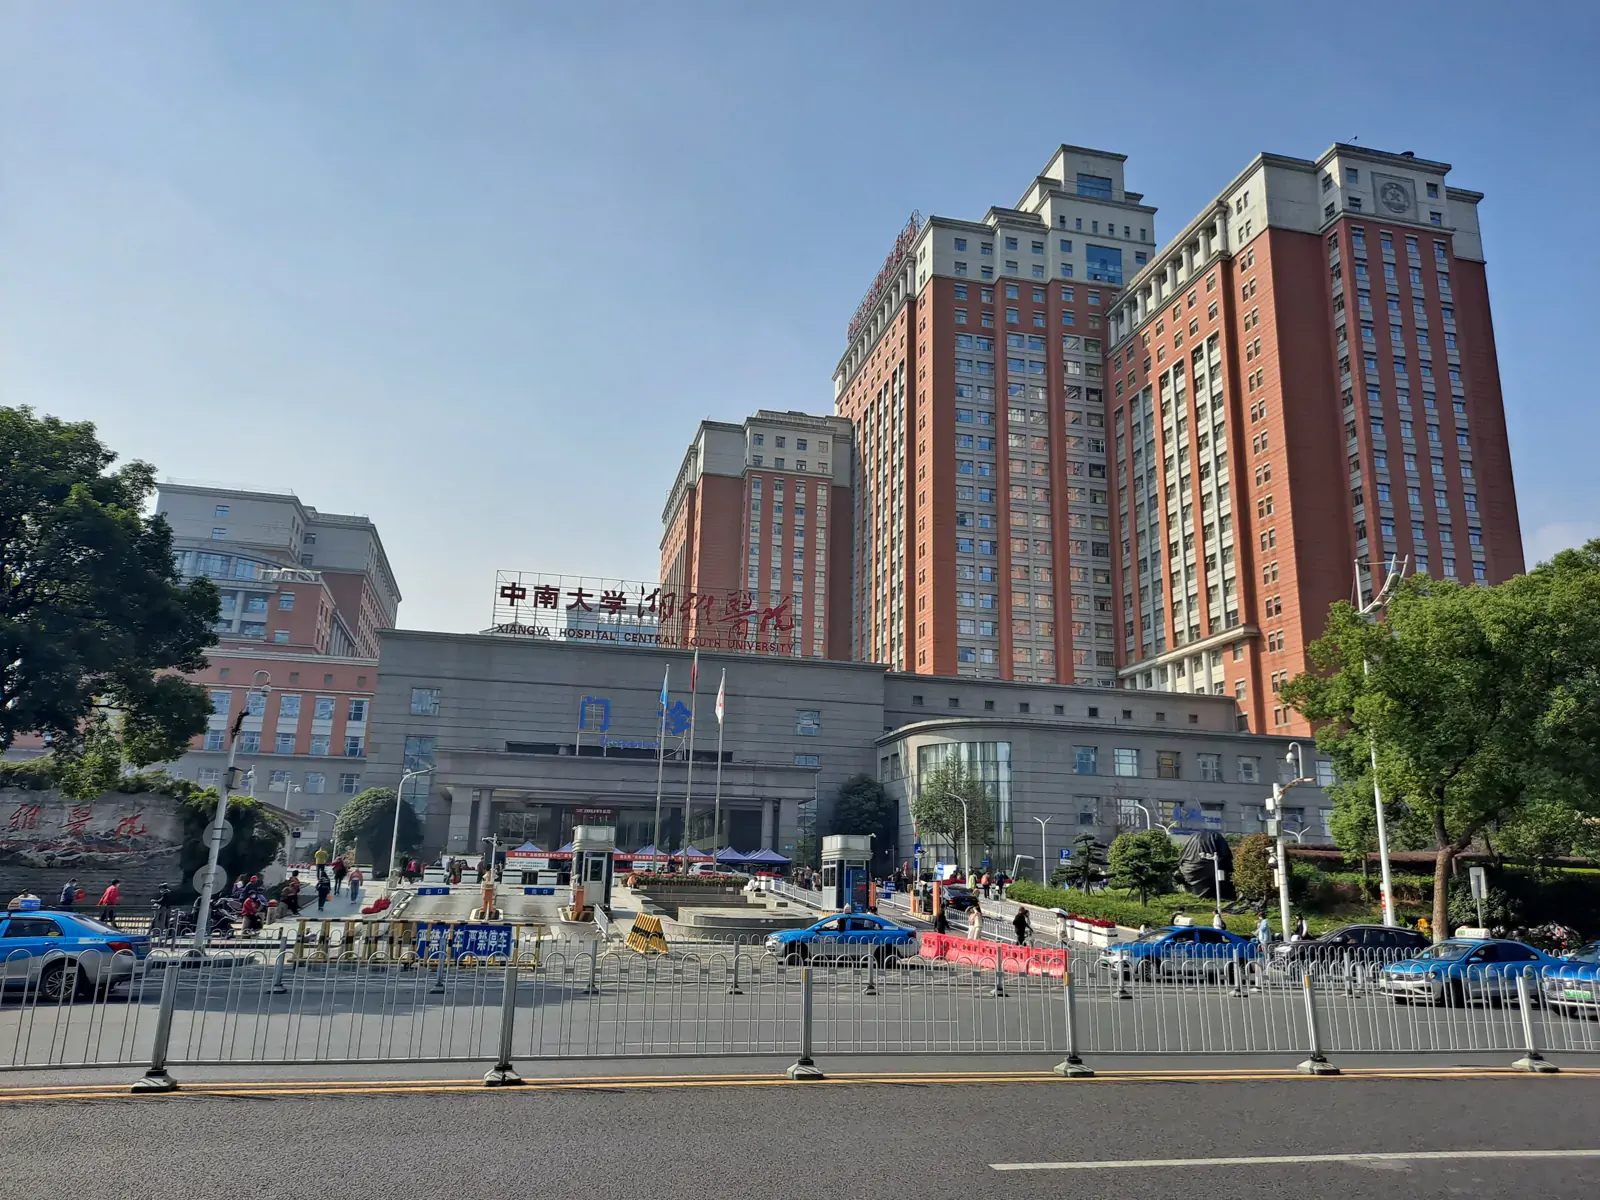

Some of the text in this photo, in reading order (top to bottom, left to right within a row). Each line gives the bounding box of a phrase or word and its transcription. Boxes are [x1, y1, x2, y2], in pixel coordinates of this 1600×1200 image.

[497, 624, 794, 653] XIANGYA HOSPITAL CENTRAL SOUTH UNIVERSITY
[580, 696, 691, 735] 门诊
[466, 929, 508, 952] 严禁停车
